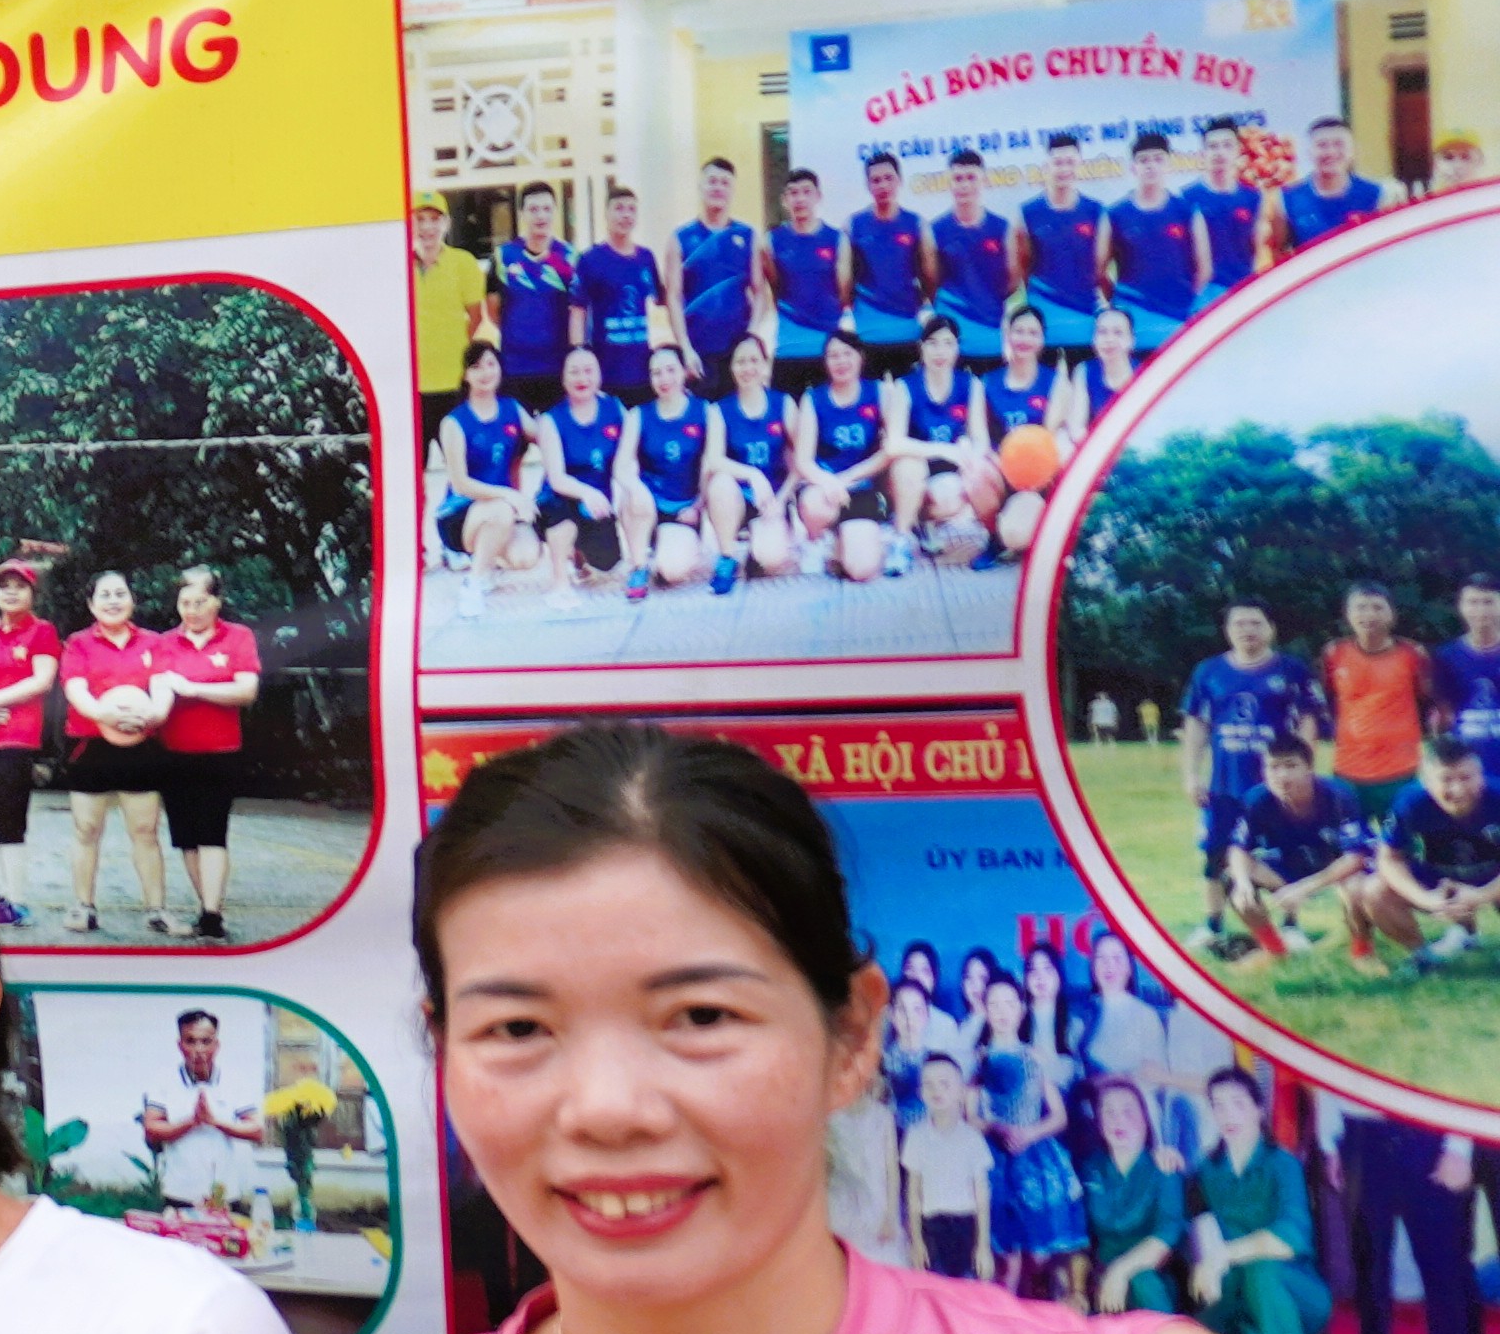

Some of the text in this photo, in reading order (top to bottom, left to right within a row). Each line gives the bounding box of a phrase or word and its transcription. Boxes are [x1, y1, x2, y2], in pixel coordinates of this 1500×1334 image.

[946, 53, 1034, 97] BÓNG
[1045, 32, 1186, 84] CHUYỀN
[1193, 51, 1257, 97] HƠI
[775, 734, 834, 784] XÃ
[842, 730, 915, 792] HỘI
[925, 721, 1006, 782] CHỦ
[978, 848, 1044, 870] BAN
